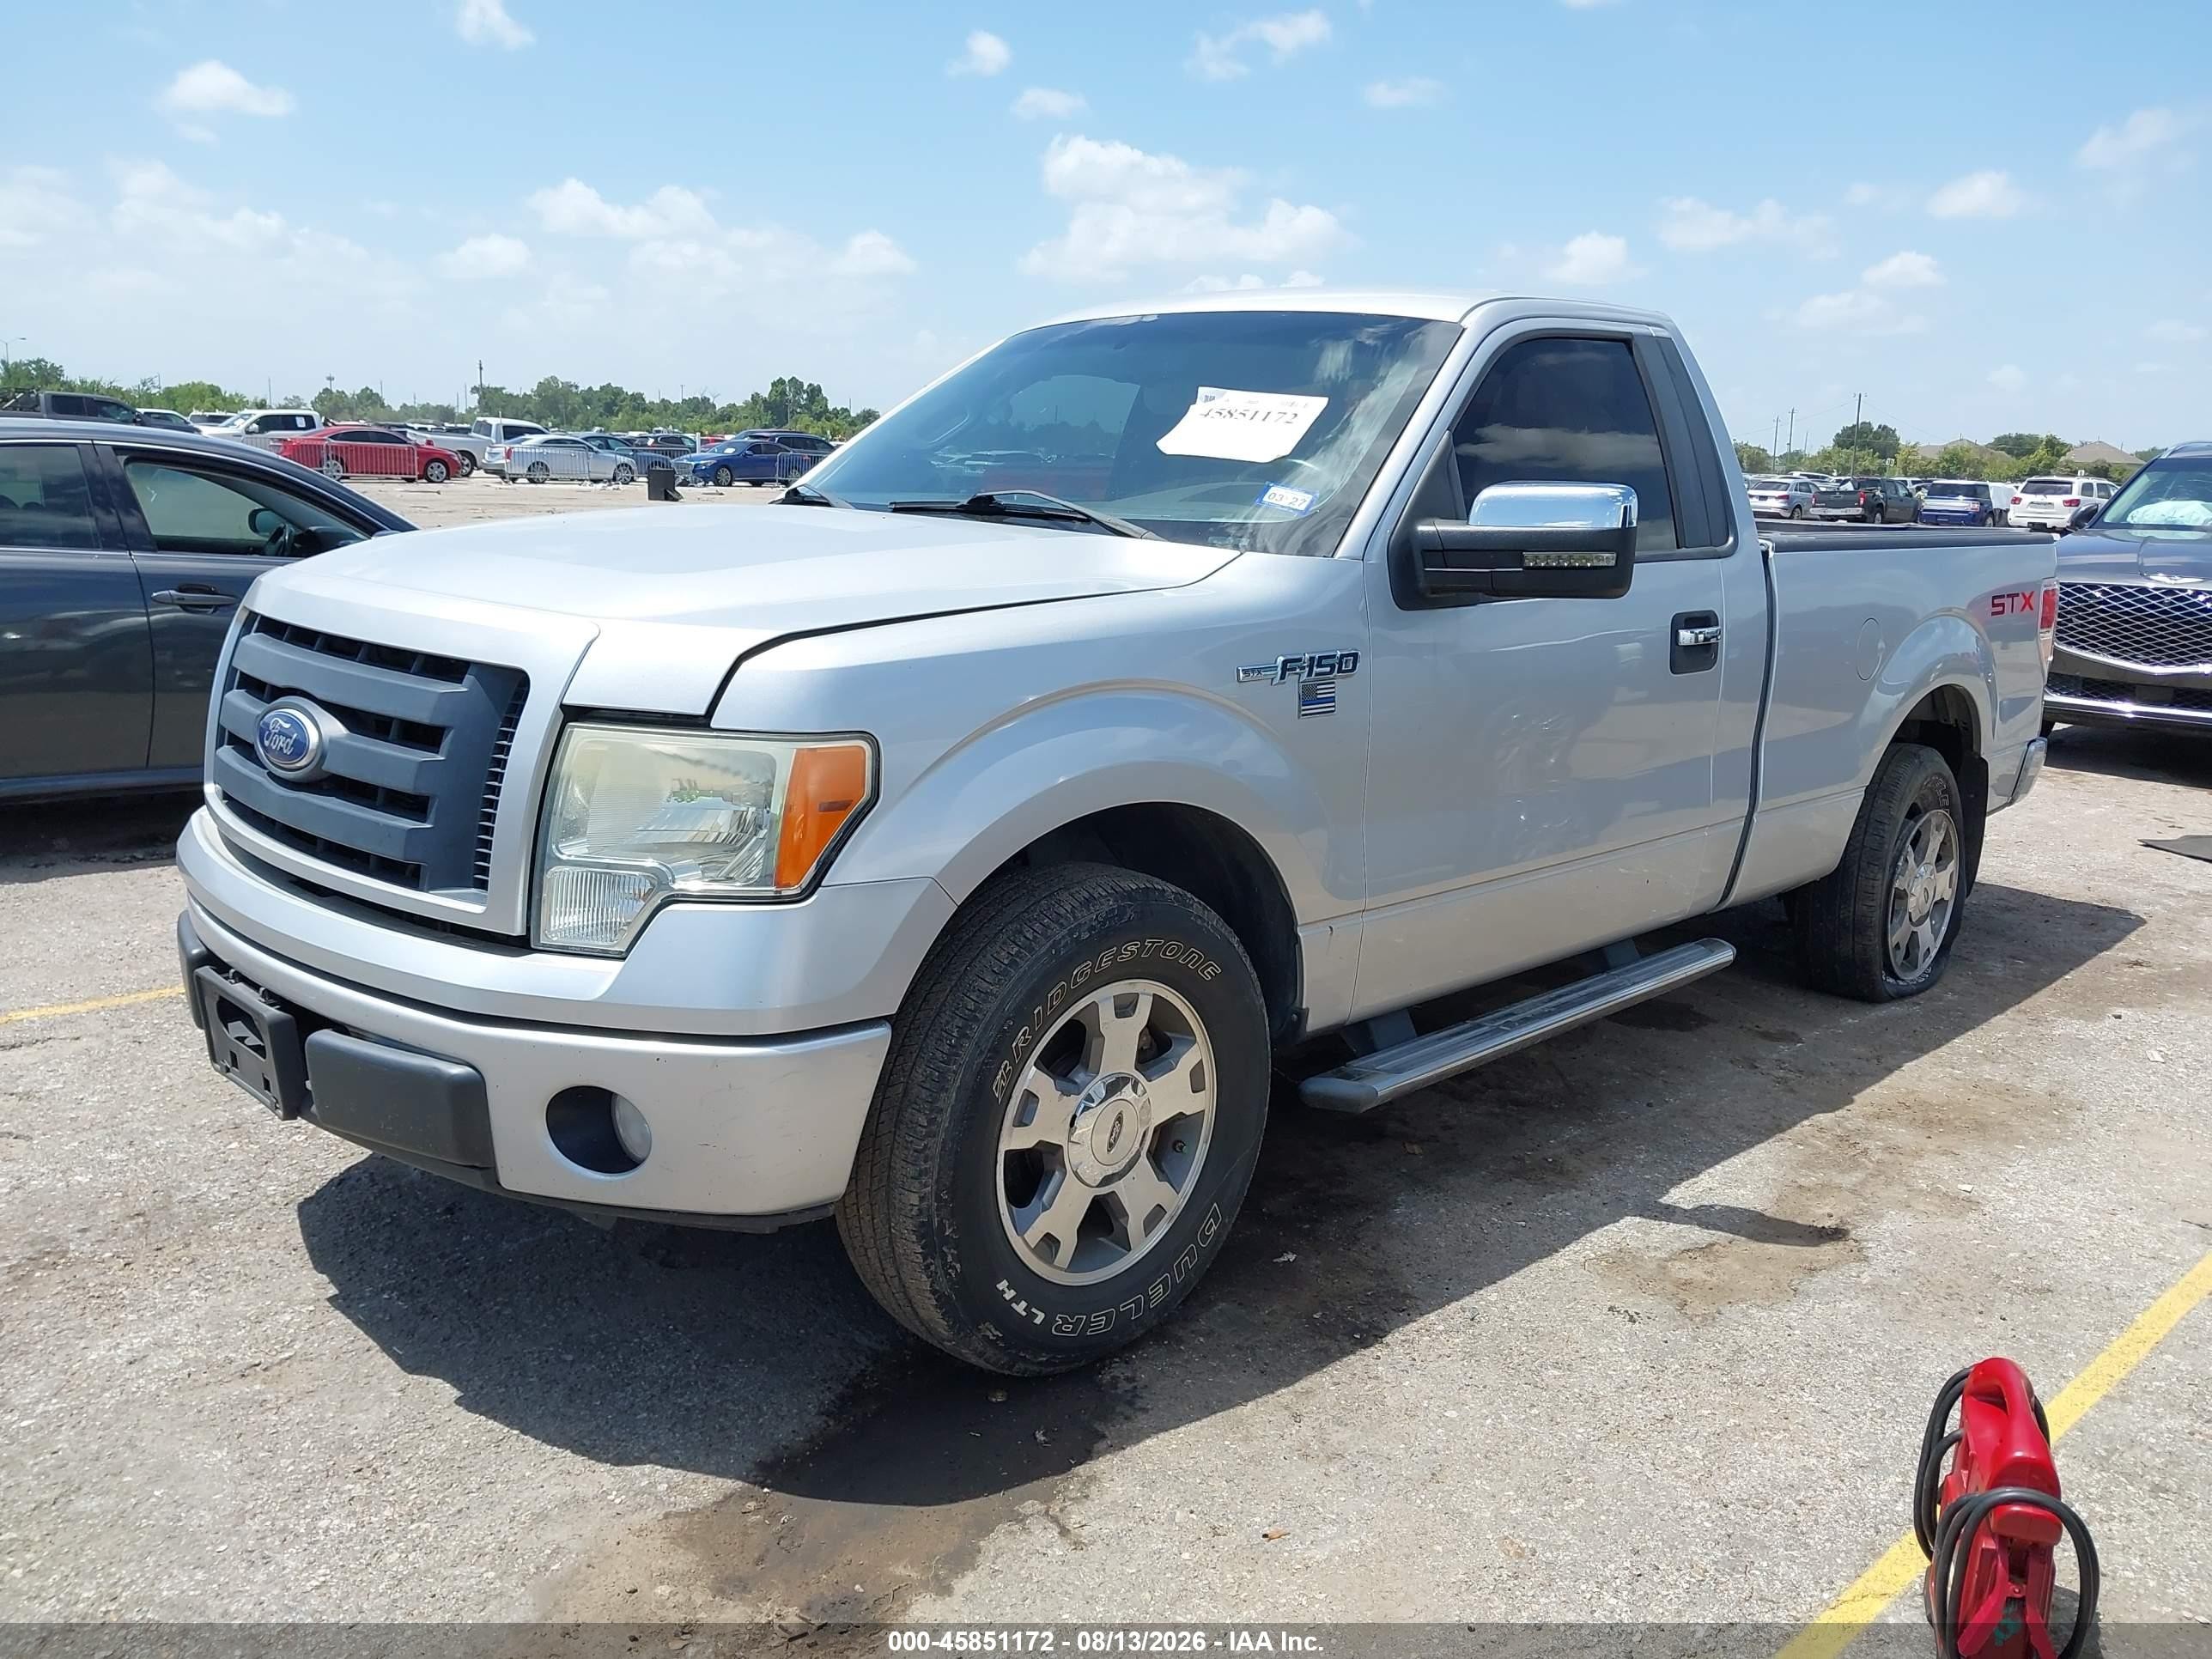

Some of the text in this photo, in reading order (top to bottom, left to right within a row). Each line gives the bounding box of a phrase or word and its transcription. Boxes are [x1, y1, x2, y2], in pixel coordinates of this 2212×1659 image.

[1199, 408, 1298, 424] 45851172
[1991, 591, 2034, 617] STX
[1273, 652, 1361, 685] F-150
[263, 717, 297, 756] Ford
[992, 939, 1222, 1104] BRIDGESTONE
[1052, 1202, 1222, 1338] DUELER
